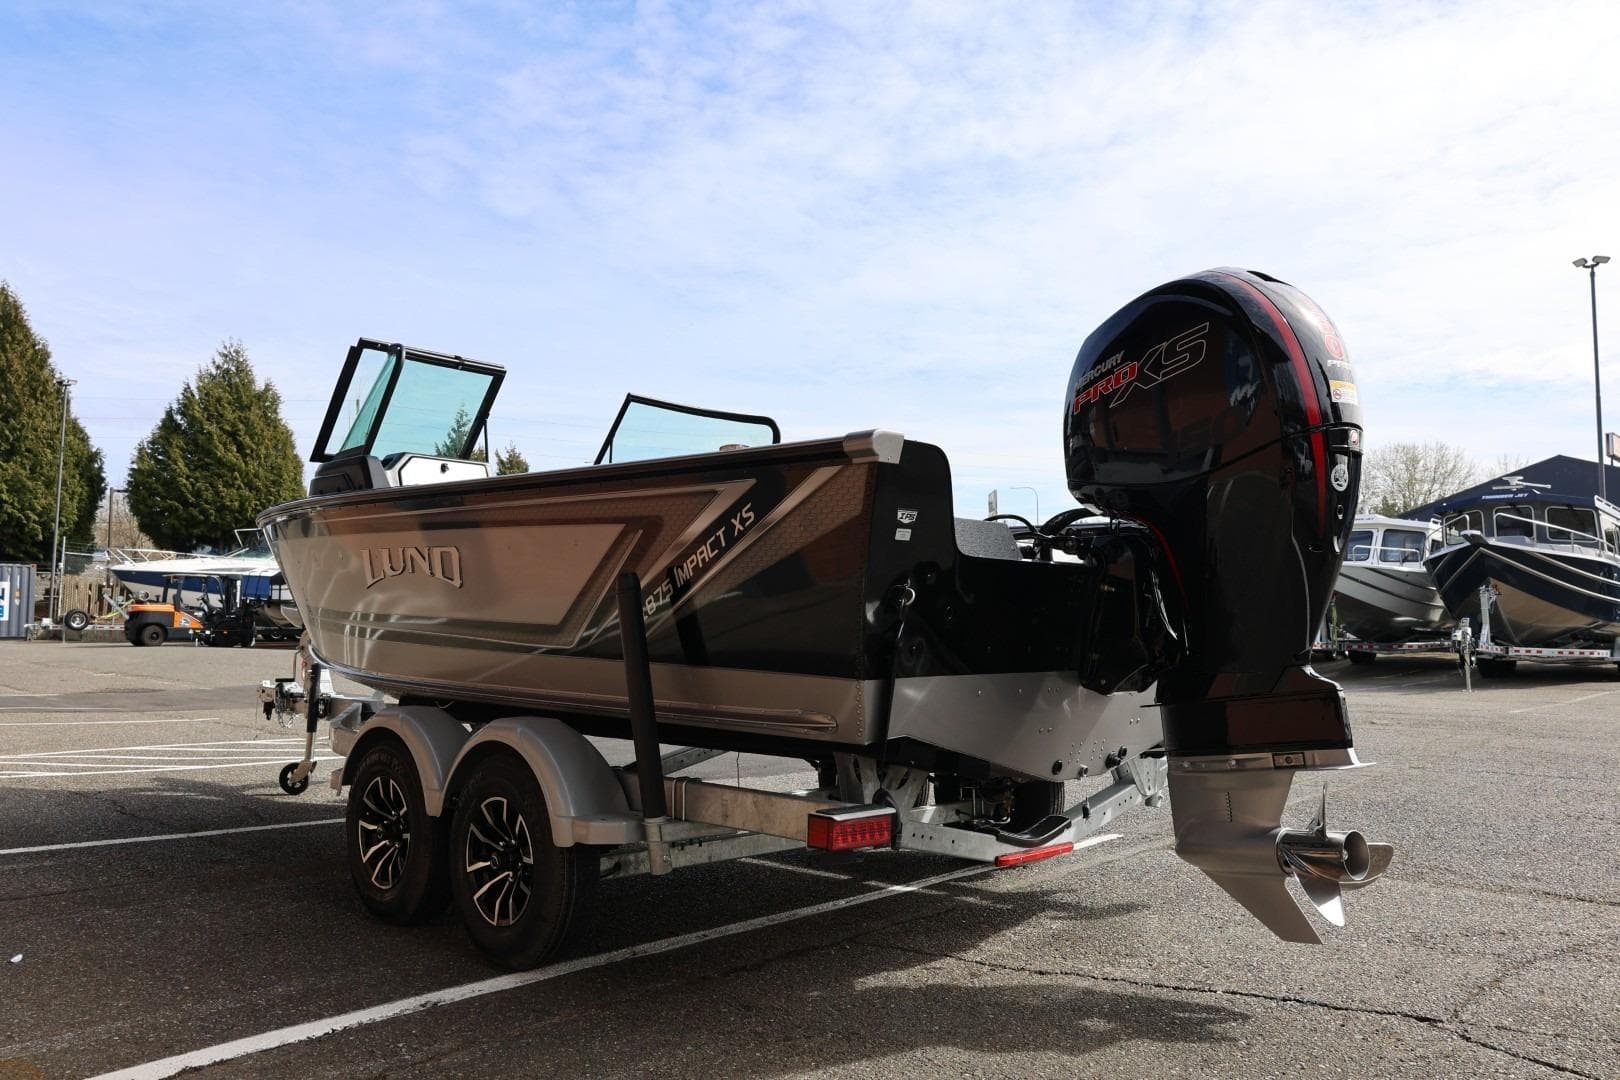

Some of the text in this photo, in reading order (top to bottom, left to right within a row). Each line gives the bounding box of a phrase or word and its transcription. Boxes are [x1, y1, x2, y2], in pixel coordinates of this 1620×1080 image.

[1075, 350, 1125, 390] MERCURY
[673, 526, 726, 588] IMPACT
[730, 502, 755, 537] XS
[359, 546, 463, 590] LUND
